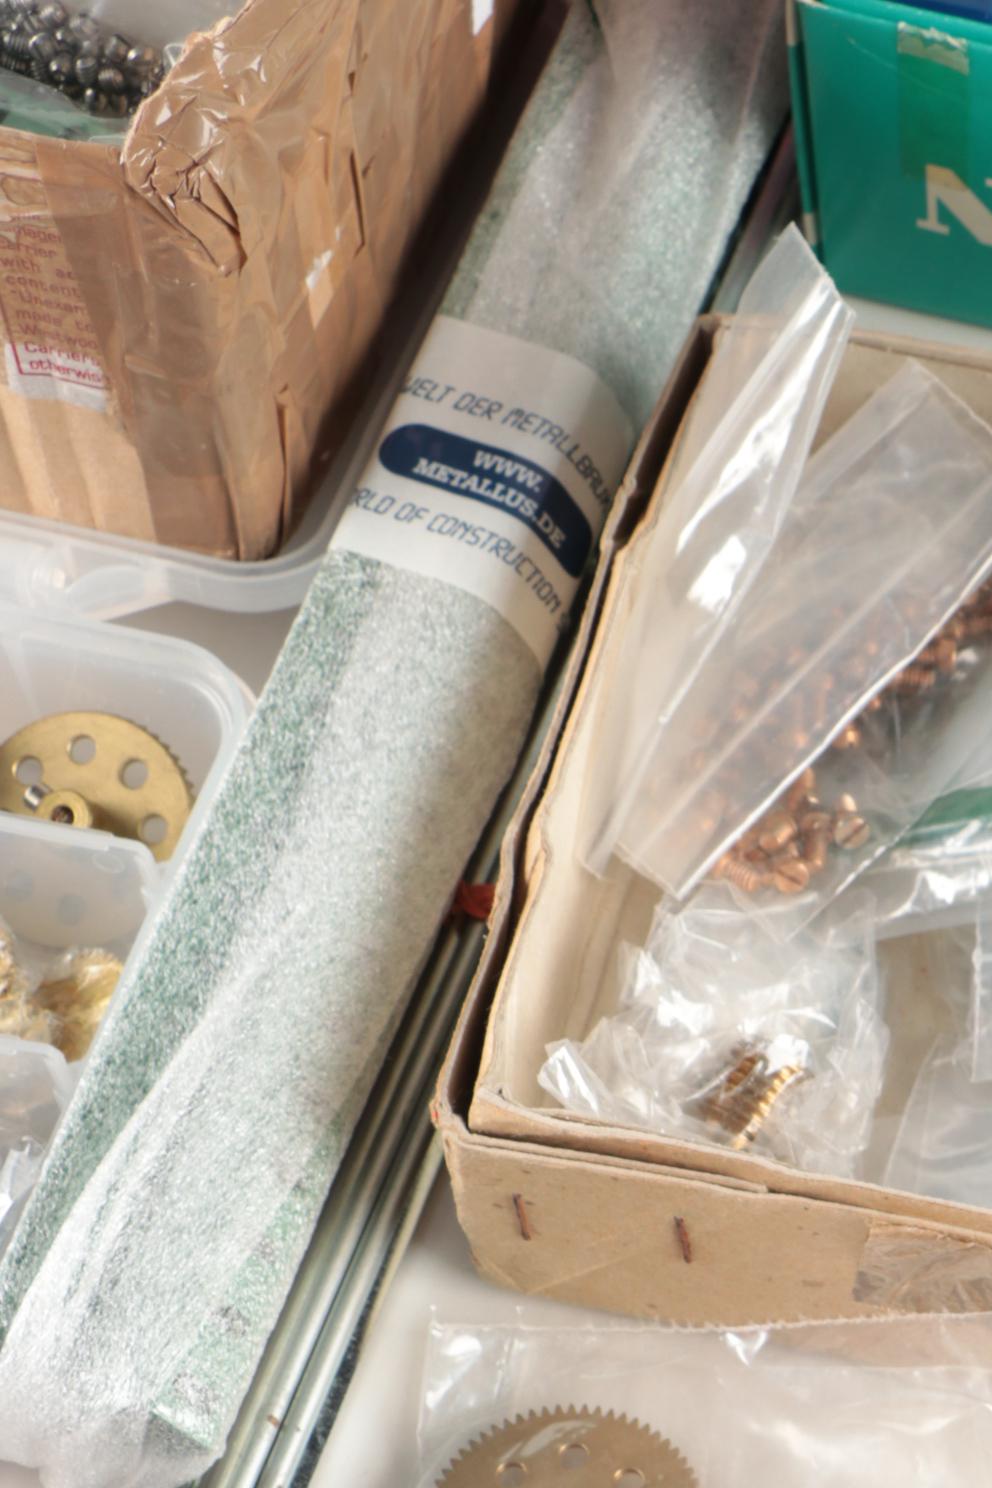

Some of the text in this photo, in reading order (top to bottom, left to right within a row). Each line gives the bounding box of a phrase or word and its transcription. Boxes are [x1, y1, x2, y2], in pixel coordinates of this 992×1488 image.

[453, 392, 503, 420] DER
[413, 458, 567, 550] METALLUS.DE
[474, 449, 543, 493] WWW.
[353, 488, 562, 614] RLD OF CONSTRUCTION
